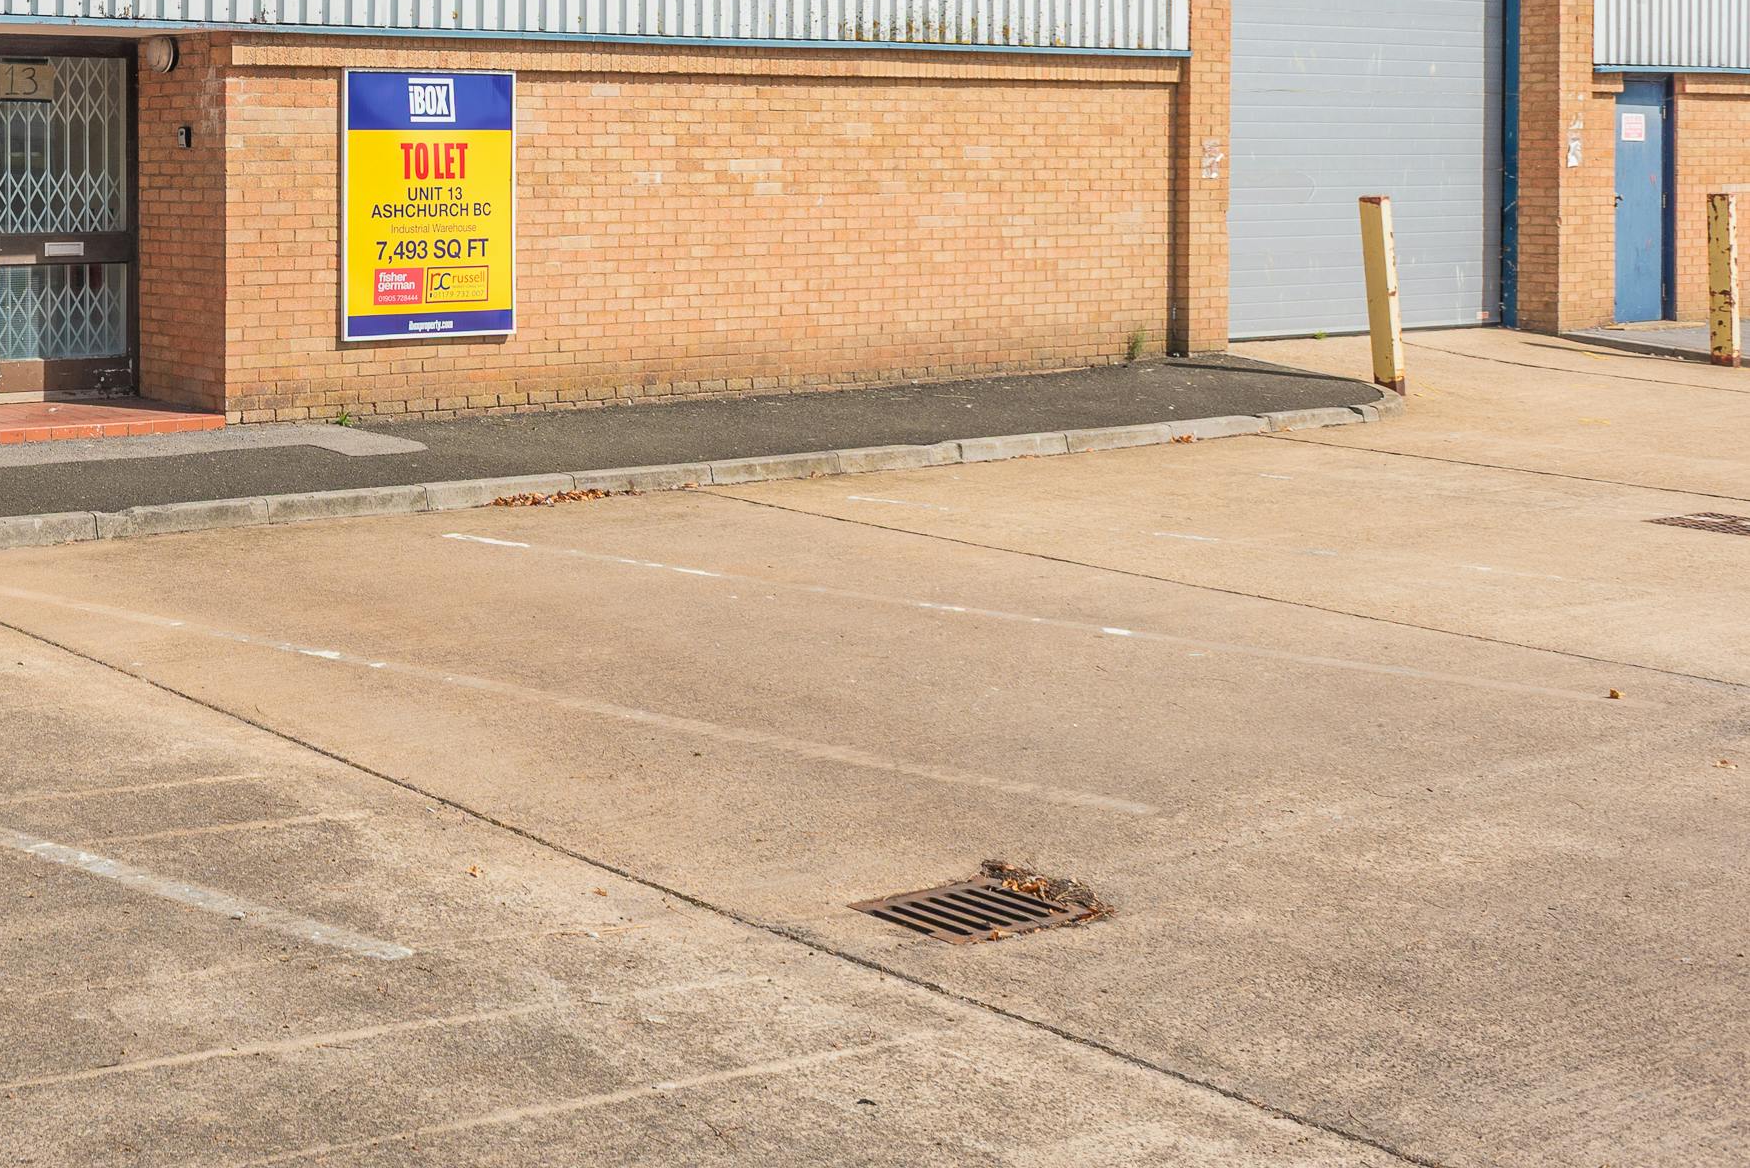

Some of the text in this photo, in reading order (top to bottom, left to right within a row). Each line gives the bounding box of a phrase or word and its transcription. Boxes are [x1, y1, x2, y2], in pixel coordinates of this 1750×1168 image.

[4, 66, 38, 97] 13
[409, 85, 449, 115] iBOX
[400, 142, 468, 180] TO LET
[407, 186, 463, 201] UNIT 13
[371, 202, 492, 219] ASHCHURCH BC
[390, 223, 477, 234] Industrial Warehouse
[376, 238, 489, 264] 7,493 SQ FT
[379, 272, 407, 282] fisher
[452, 271, 485, 283] russell
[378, 280, 415, 293] german
